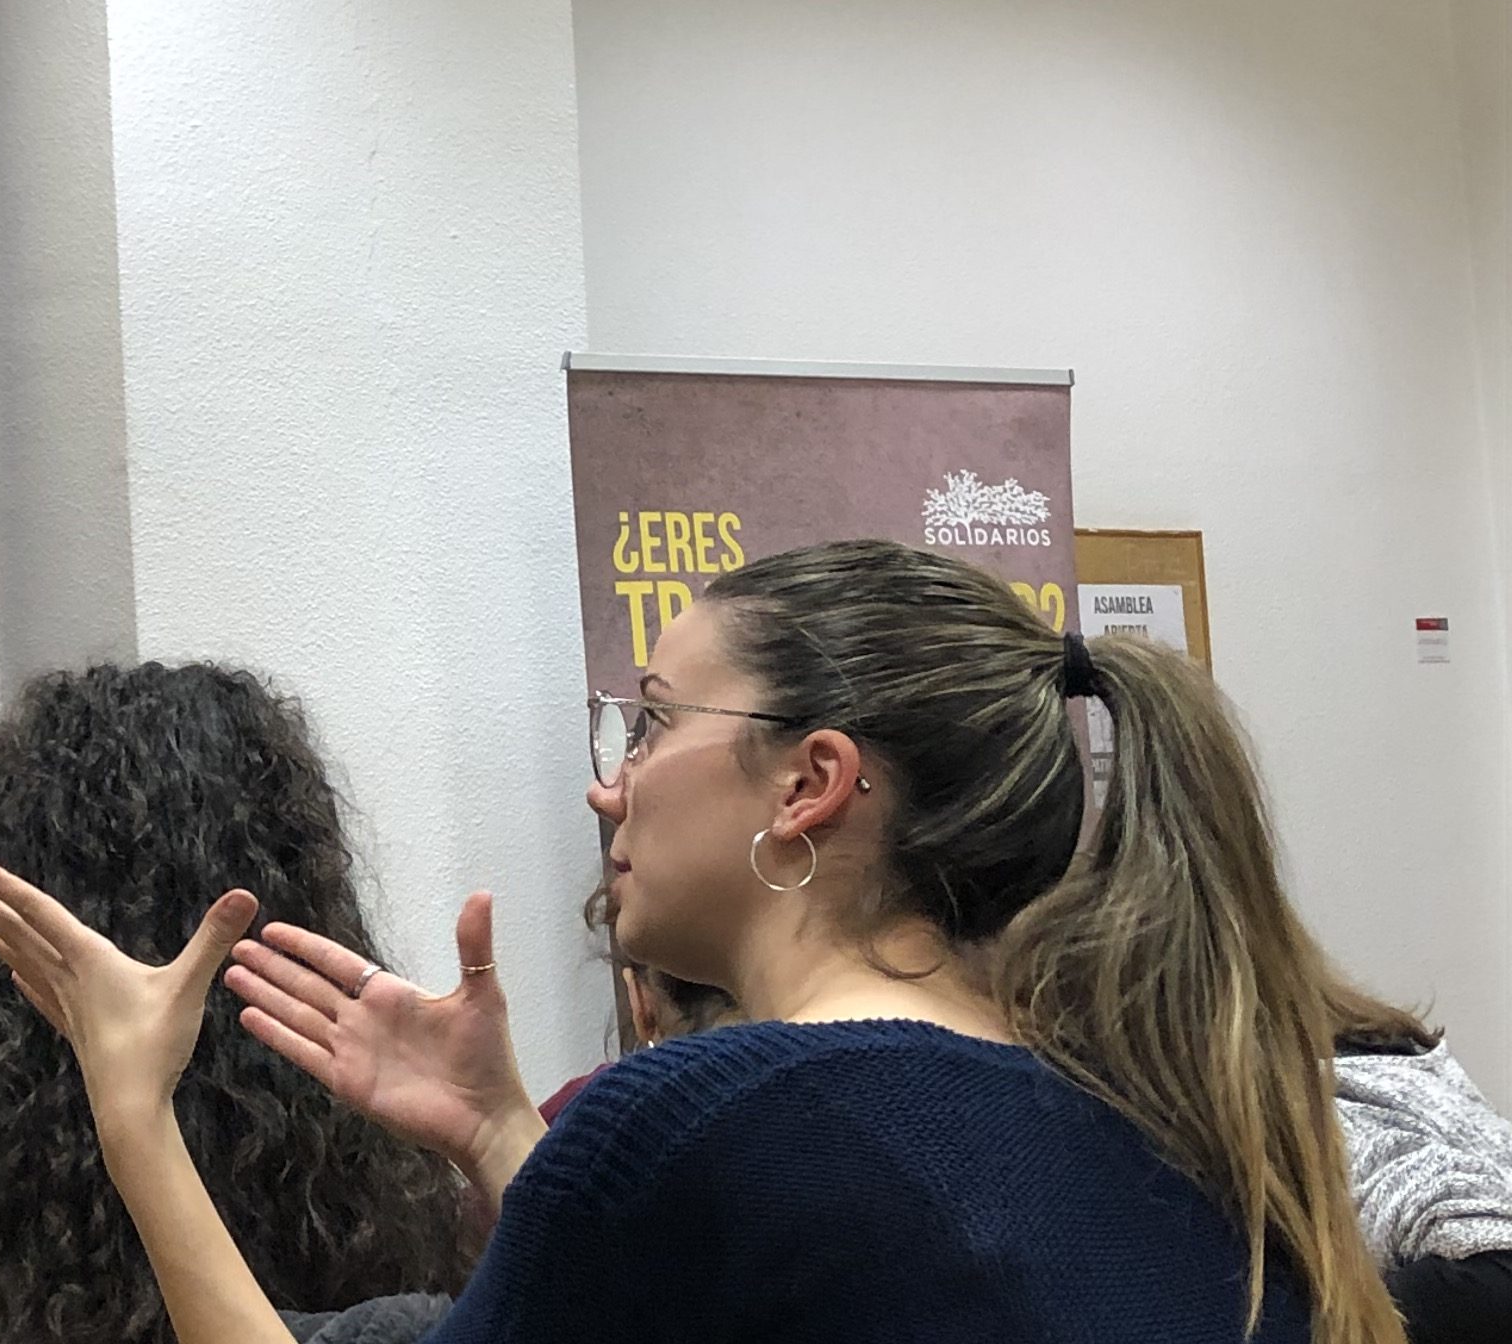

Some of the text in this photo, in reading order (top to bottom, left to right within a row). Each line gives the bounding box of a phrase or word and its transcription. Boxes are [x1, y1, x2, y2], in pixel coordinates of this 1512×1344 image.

[613, 512, 745, 573] ¿ERES
[924, 527, 1051, 546] SOLIDARIOS
[1094, 596, 1154, 614] ASAMBLEA
